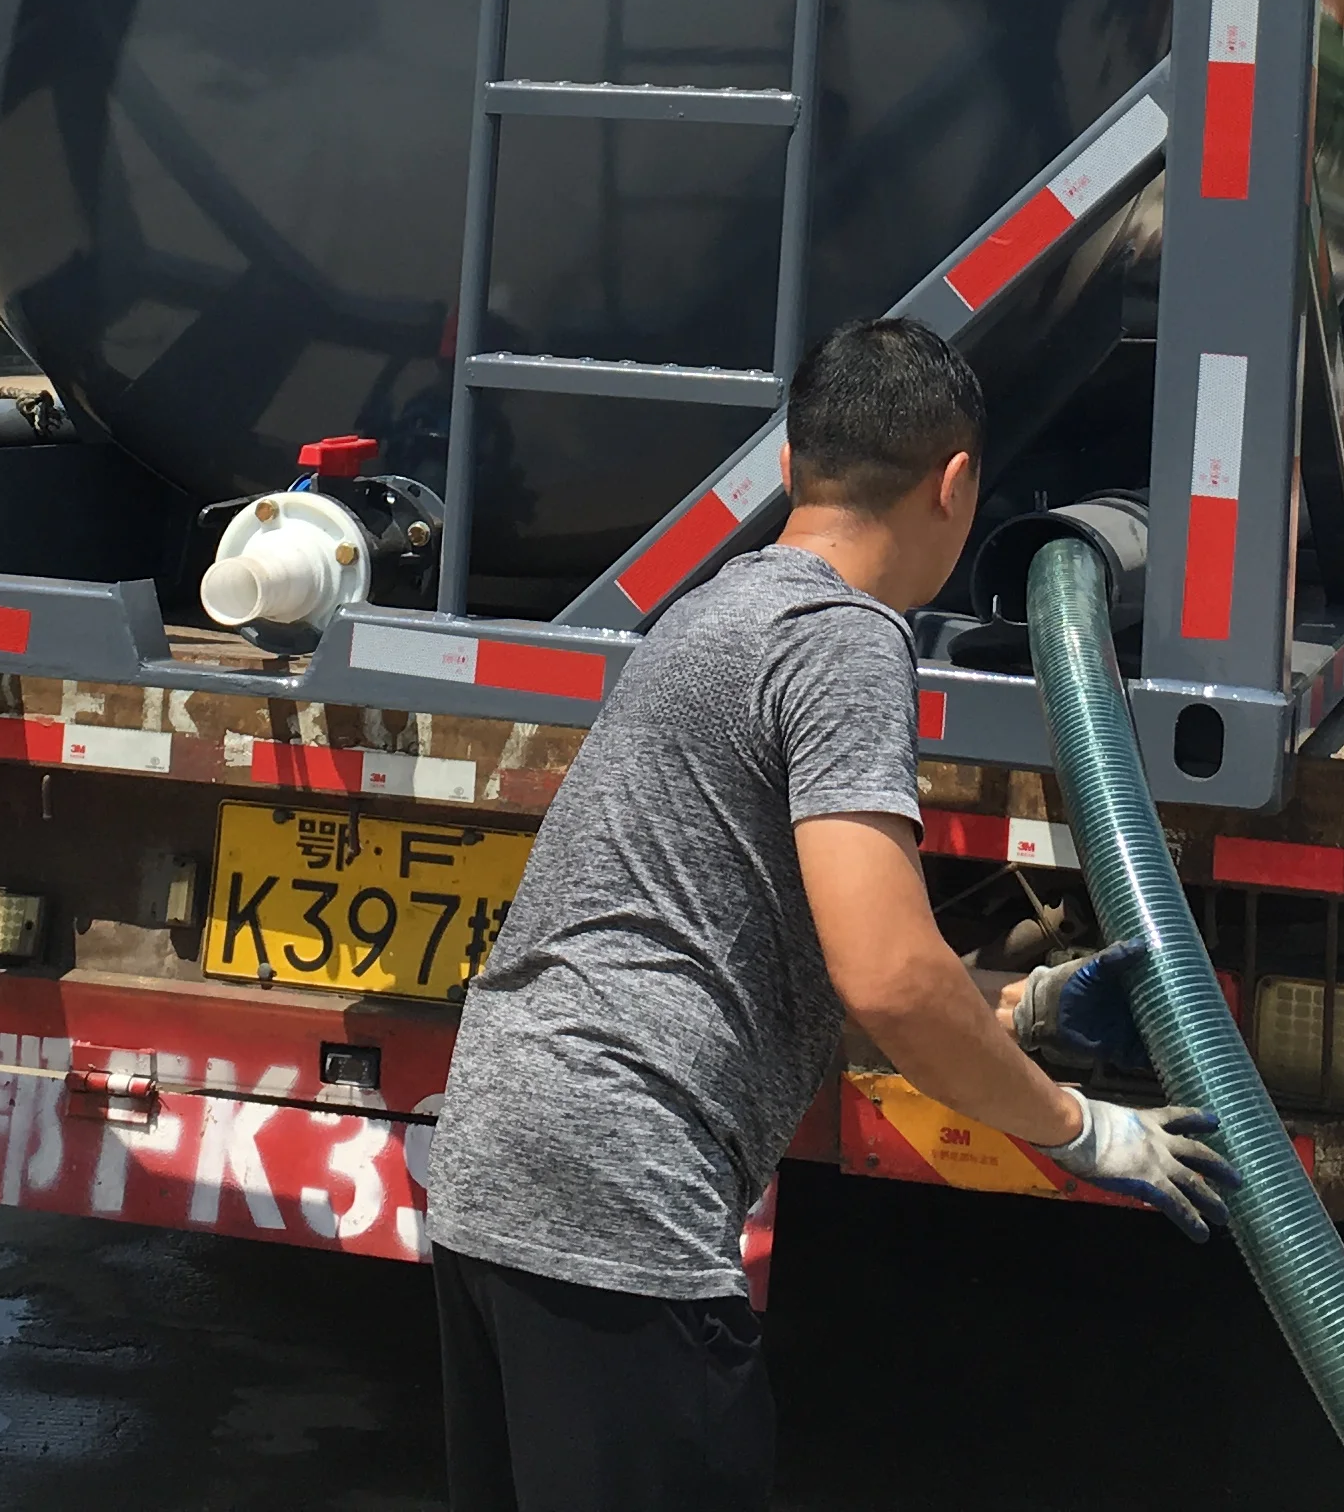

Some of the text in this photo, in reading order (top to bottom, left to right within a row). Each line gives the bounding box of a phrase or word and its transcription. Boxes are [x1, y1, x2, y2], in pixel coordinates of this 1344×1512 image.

[69, 743, 86, 754] 3M
[1017, 841, 1036, 853] 3M
[939, 1127, 971, 1146] 3M
